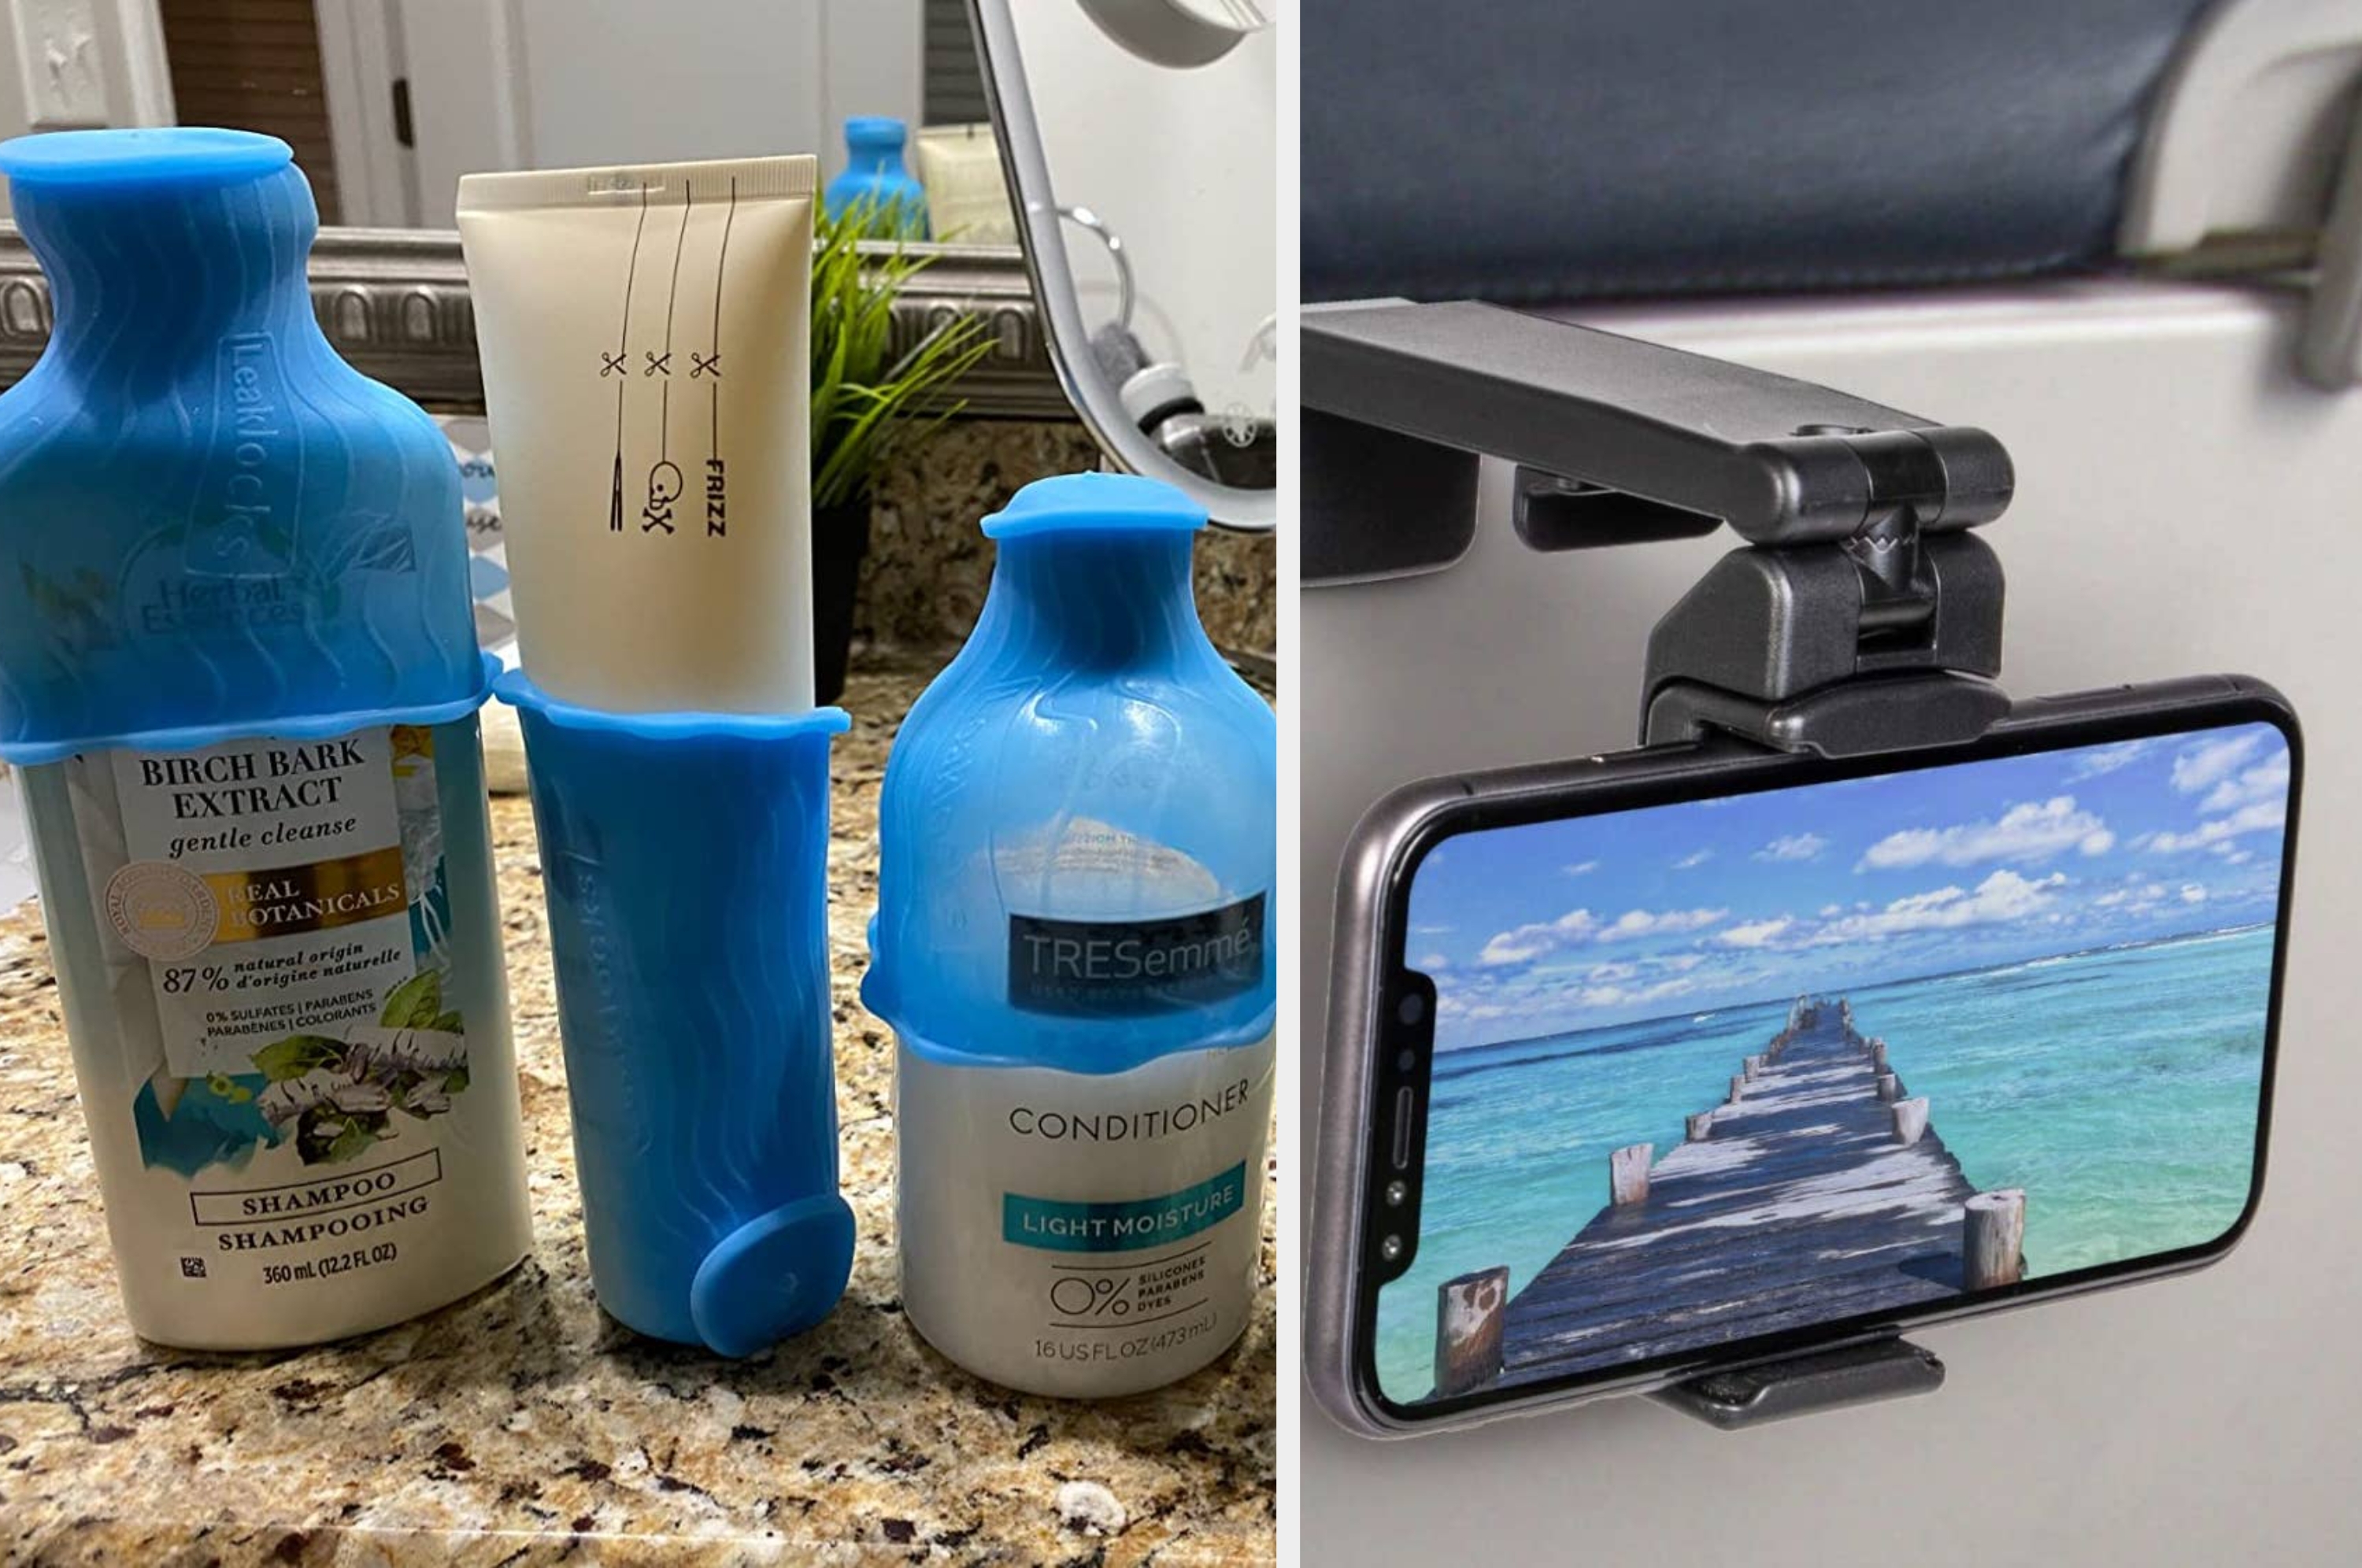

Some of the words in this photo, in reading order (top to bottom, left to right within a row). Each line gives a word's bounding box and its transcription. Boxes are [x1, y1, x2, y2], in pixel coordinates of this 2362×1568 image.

[706, 459, 726, 538] FRIZZ
[140, 753, 260, 786] BIRCH
[268, 738, 366, 777] BARK
[172, 776, 343, 819] EXTRACT
[169, 827, 252, 859] gentle
[262, 815, 358, 845] cleanse
[228, 882, 401, 927] BOTANICALS
[234, 951, 305, 974] natural
[309, 943, 364, 963] origin
[236, 969, 318, 989] d'origine
[323, 949, 402, 977] naturelle
[1024, 915, 1252, 980] TRESemmé
[206, 1011, 229, 1023] 0%
[230, 1005, 295, 1022] SULFATES
[305, 989, 374, 1011] PARABENS
[296, 1002, 377, 1027] COLORANTS
[1009, 1078, 1249, 1141] CONDITIONER
[242, 1171, 397, 1216] SHAMPOO
[1024, 1212, 1107, 1237] LIGHT
[1113, 1184, 1235, 1236] MOISTURE
[218, 1196, 429, 1252] SHAMPOOING
[263, 1264, 291, 1285] 360
[294, 1261, 317, 1280] mL
[318, 1253, 351, 1278] (12.2
[354, 1251, 371, 1268] FL
[372, 1241, 398, 1263] OZ)
[1138, 1256, 1206, 1285] SILICONES
[1138, 1269, 1205, 1299] PARABENS
[1050, 1277, 1131, 1316] 0%
[1138, 1296, 1172, 1312] DYES
[1035, 1340, 1056, 1359] 16
[1060, 1343, 1090, 1361] US
[1092, 1343, 1118, 1361] FL
[1120, 1337, 1149, 1358] OZ
